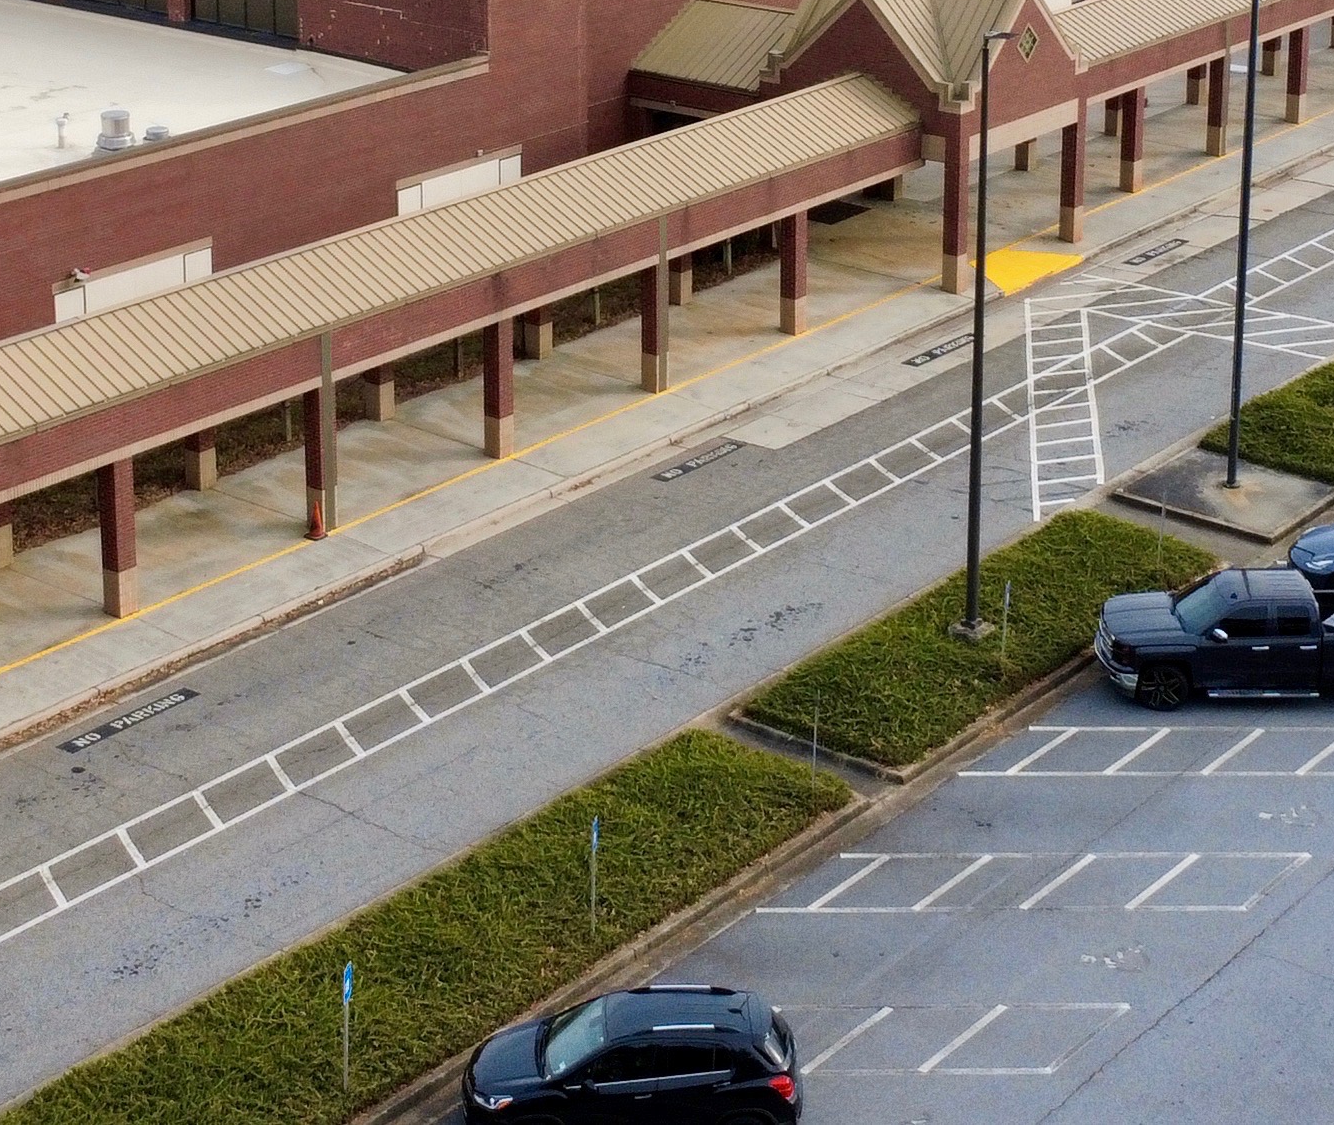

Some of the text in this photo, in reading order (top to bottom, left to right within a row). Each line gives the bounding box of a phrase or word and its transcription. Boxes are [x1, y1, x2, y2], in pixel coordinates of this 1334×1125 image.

[660, 468, 684, 478] NO
[71, 693, 186, 748] NO PARKING
